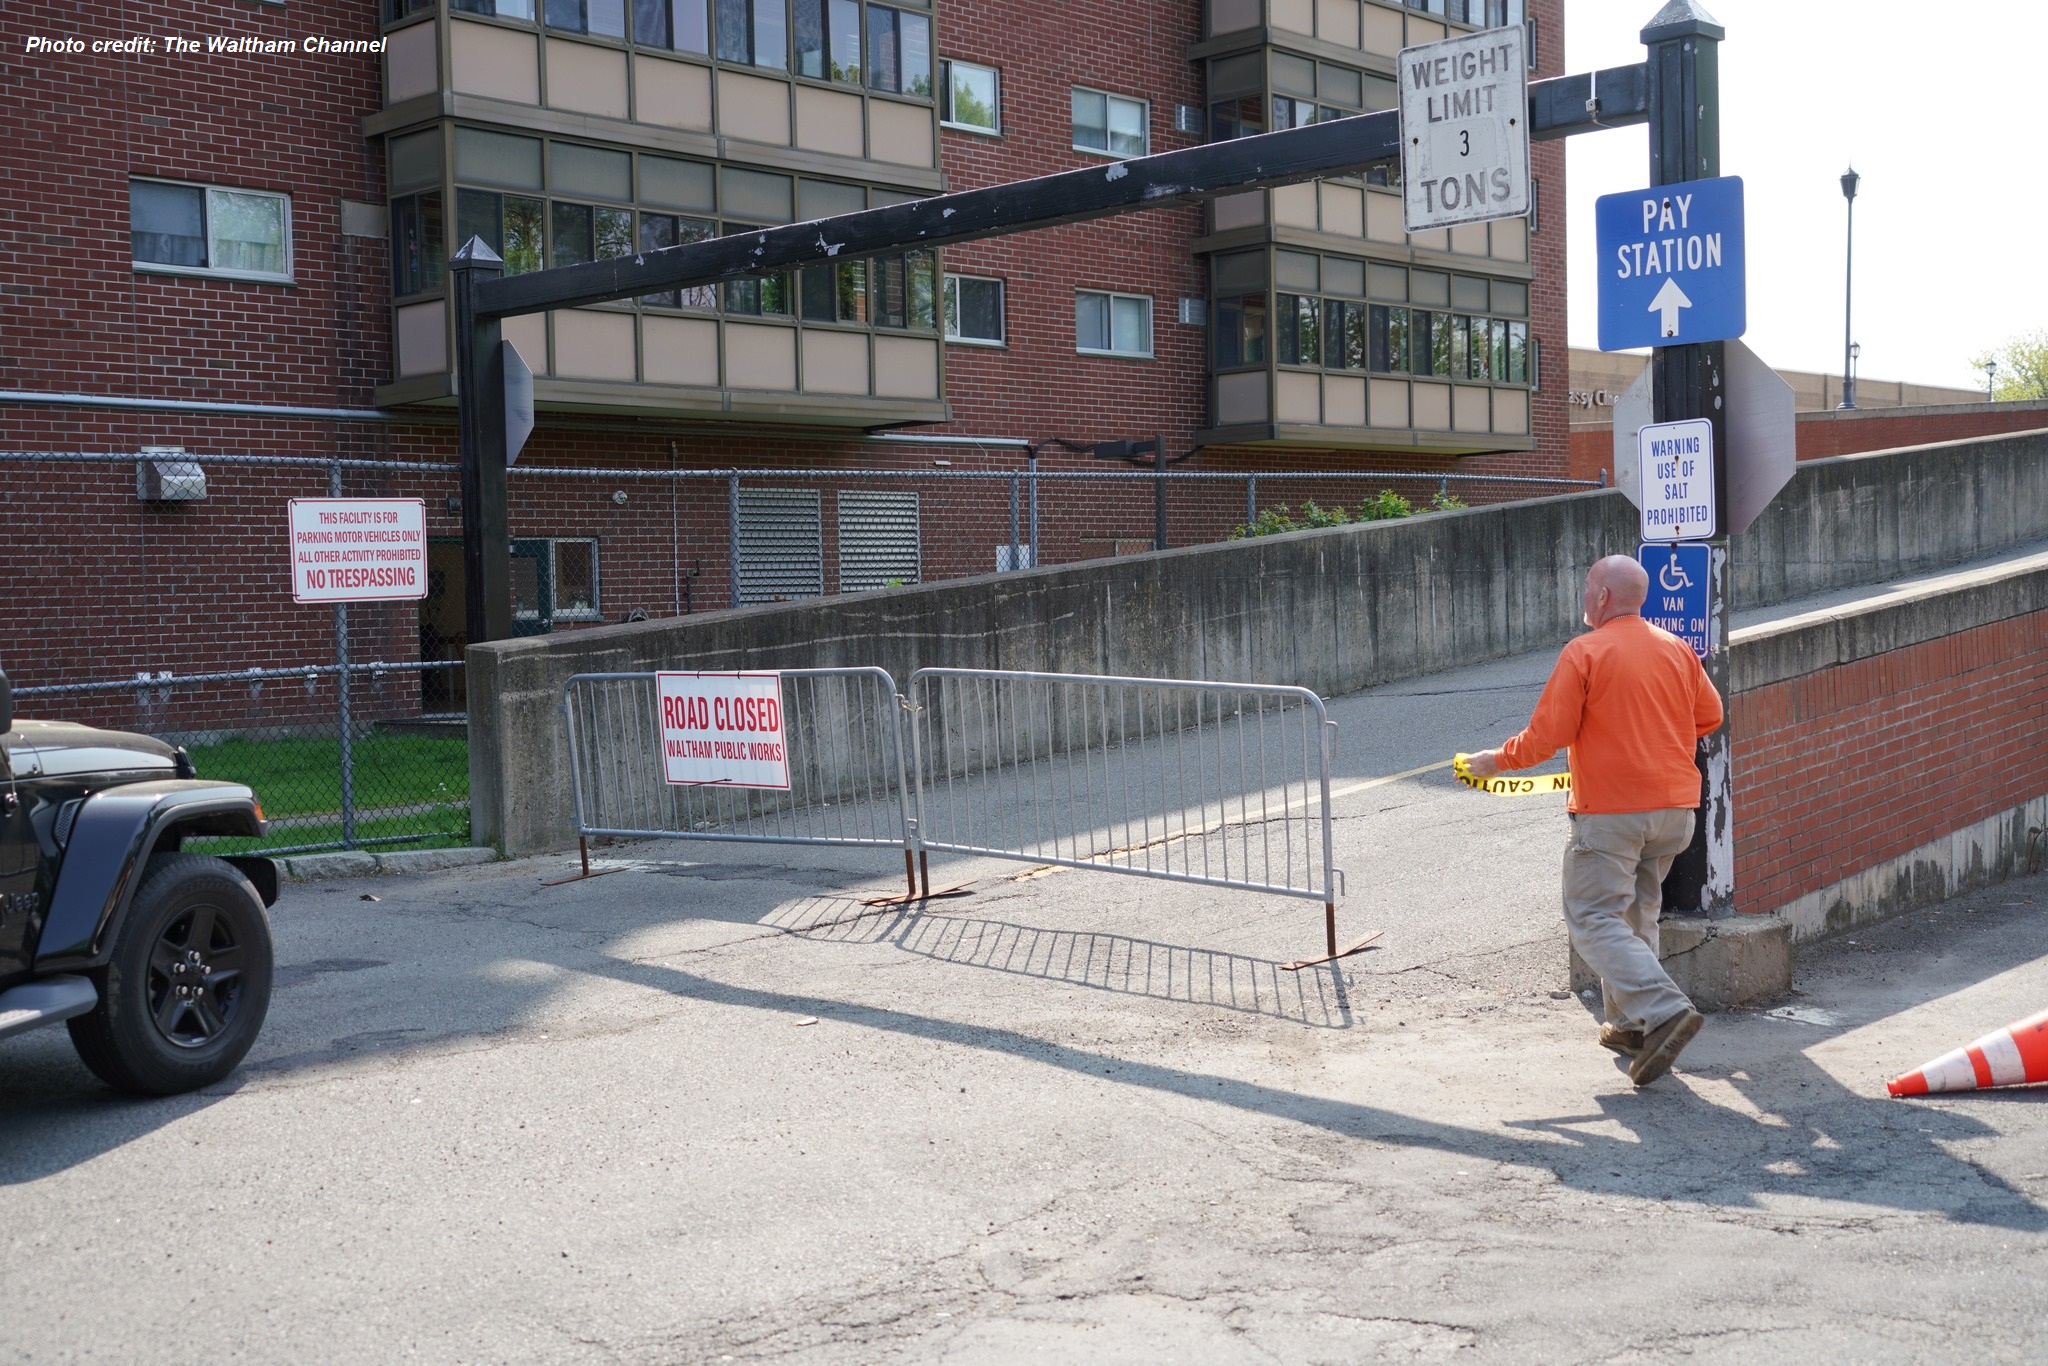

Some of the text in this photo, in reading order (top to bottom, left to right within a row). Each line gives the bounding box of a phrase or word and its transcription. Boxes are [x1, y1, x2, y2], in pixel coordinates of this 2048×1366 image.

[1412, 43, 1513, 90] WEIGHT
[1427, 84, 1497, 123] LIMIT
[1459, 130, 1470, 157] 3
[1421, 168, 1511, 213] TONS
[1642, 194, 1693, 234] PAY
[1617, 233, 1722, 279] STATION
[1651, 436, 1700, 457] WARNING
[1657, 460, 1694, 479] USE OF
[1664, 482, 1688, 500] SALT
[319, 511, 398, 524] THIS FACILITY IS FOR
[1647, 505, 1708, 526] PROHIBITED
[297, 530, 421, 544] PARKING MOTOR VEHICLES ONLY
[298, 549, 421, 563] ALL OTHER ACTIVITY PROHIBITED
[306, 567, 416, 589] NO TRESPASSING
[1662, 596, 1684, 611] VAN
[1642, 616, 1705, 632] ARKING ON
[663, 695, 779, 732] ROAD CLOSED
[666, 739, 782, 761] WALTHAM PUBLIC WORKS
